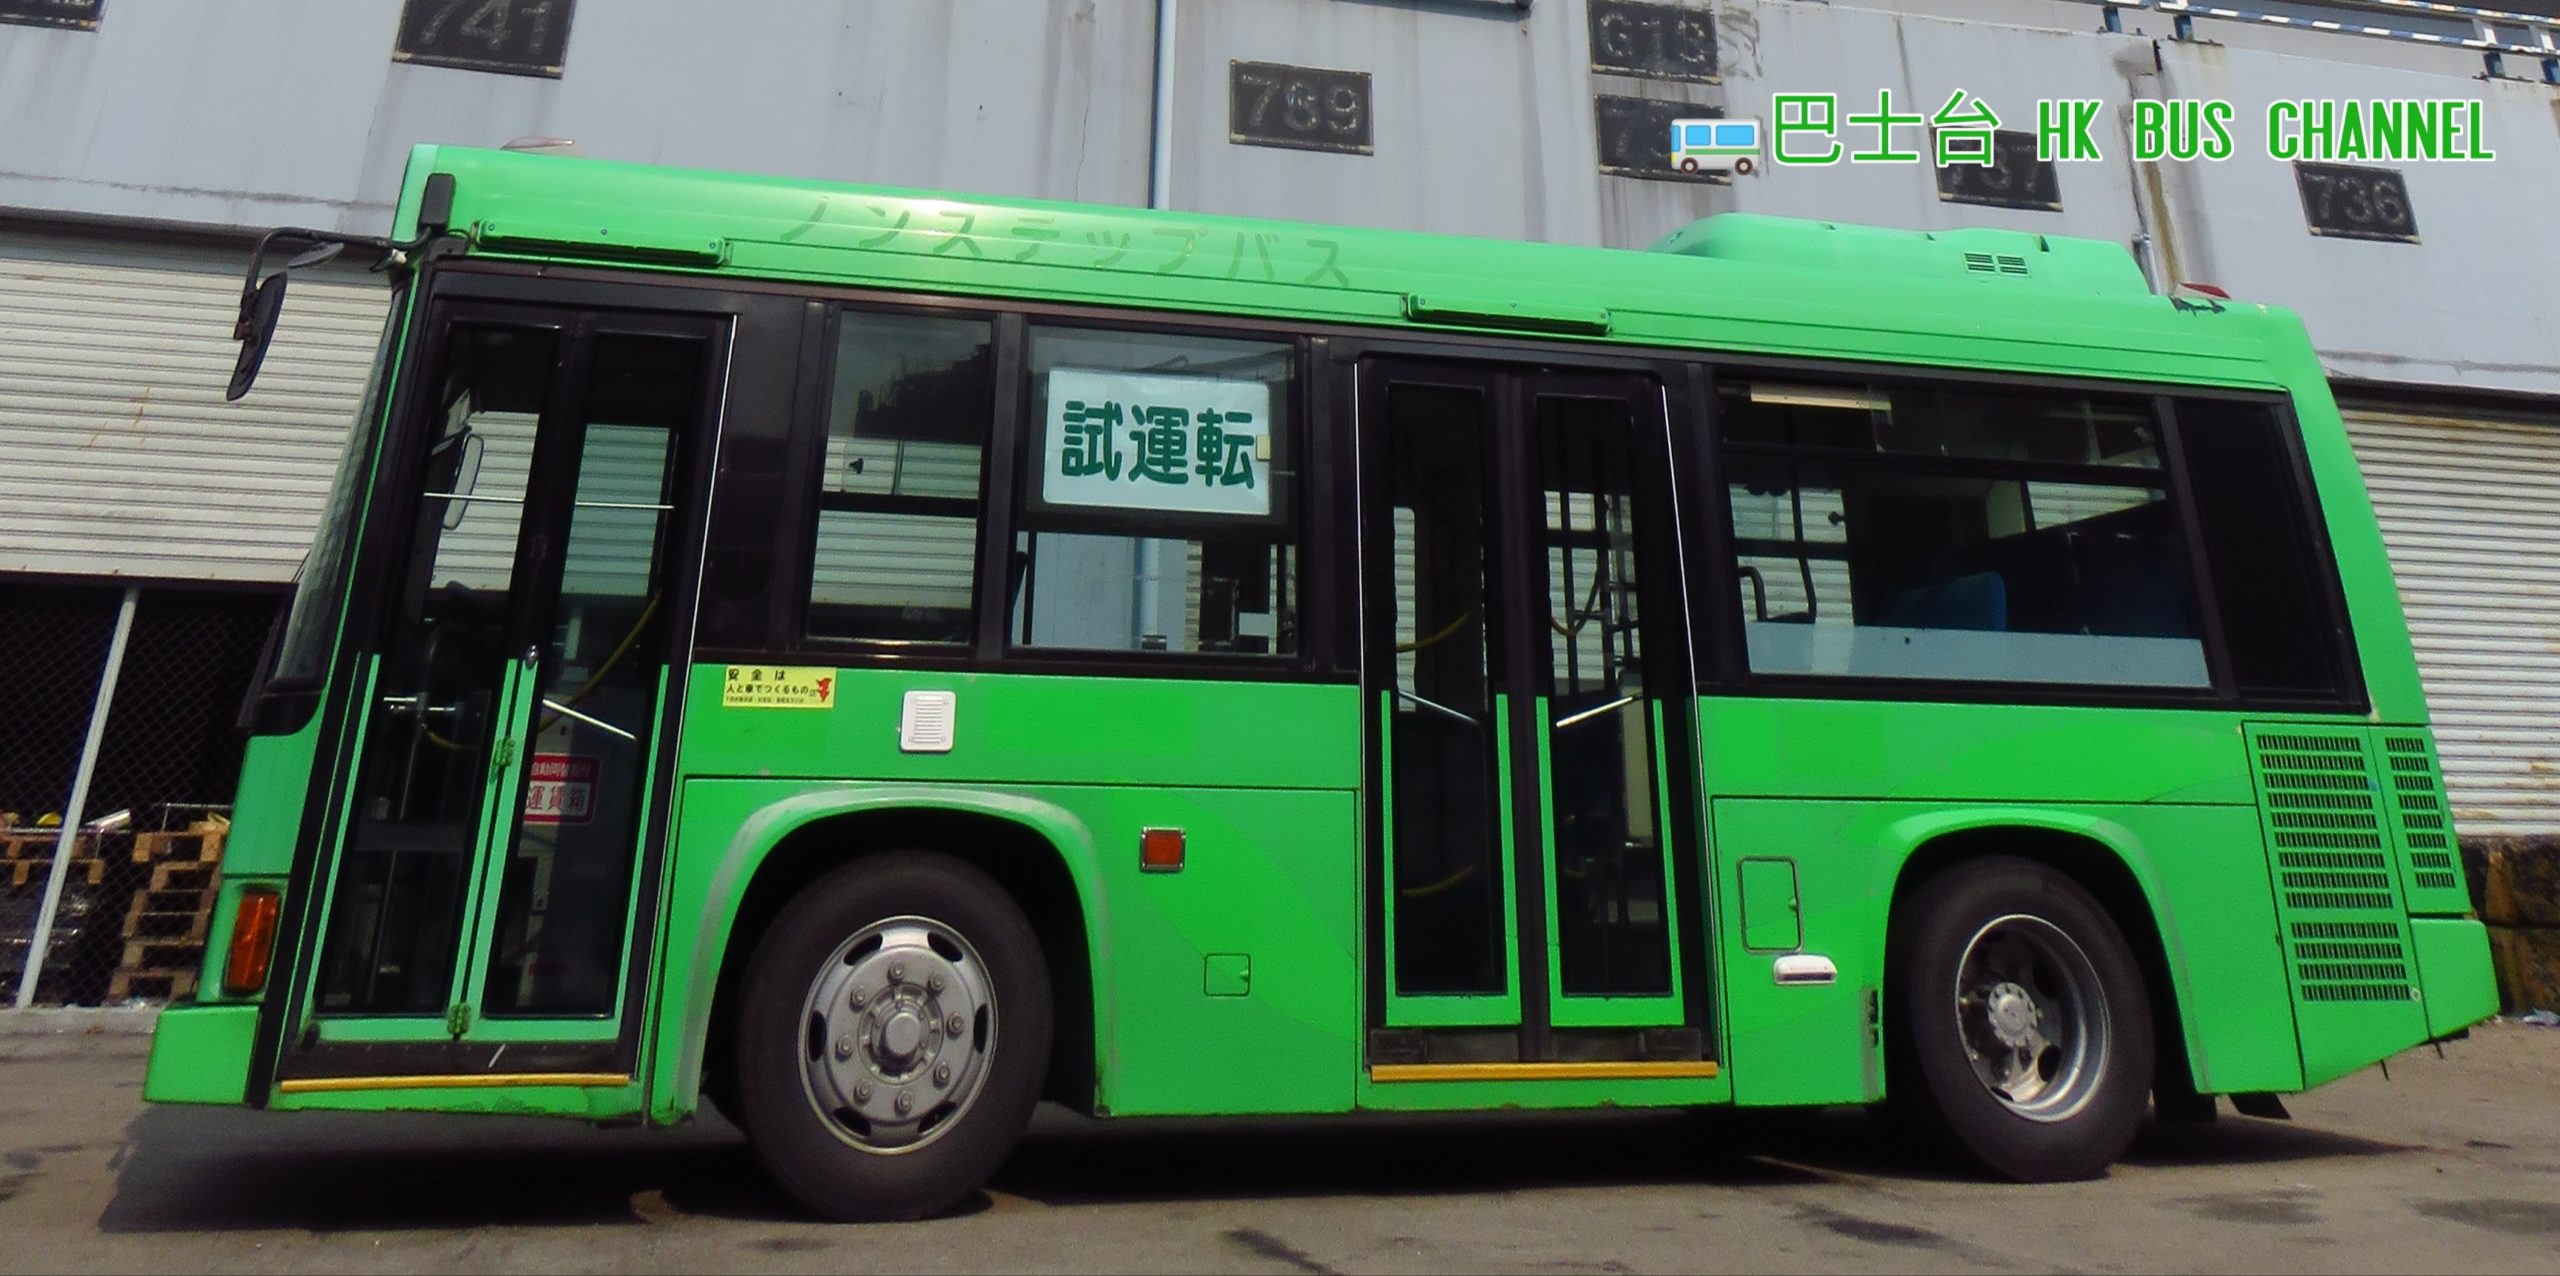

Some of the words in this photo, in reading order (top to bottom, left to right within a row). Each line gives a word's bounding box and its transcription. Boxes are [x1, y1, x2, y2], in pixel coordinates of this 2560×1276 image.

[779, 195, 1350, 288] ノンステップバス
[2303, 172, 2406, 226] 736
[1061, 401, 1255, 489] 試運転
